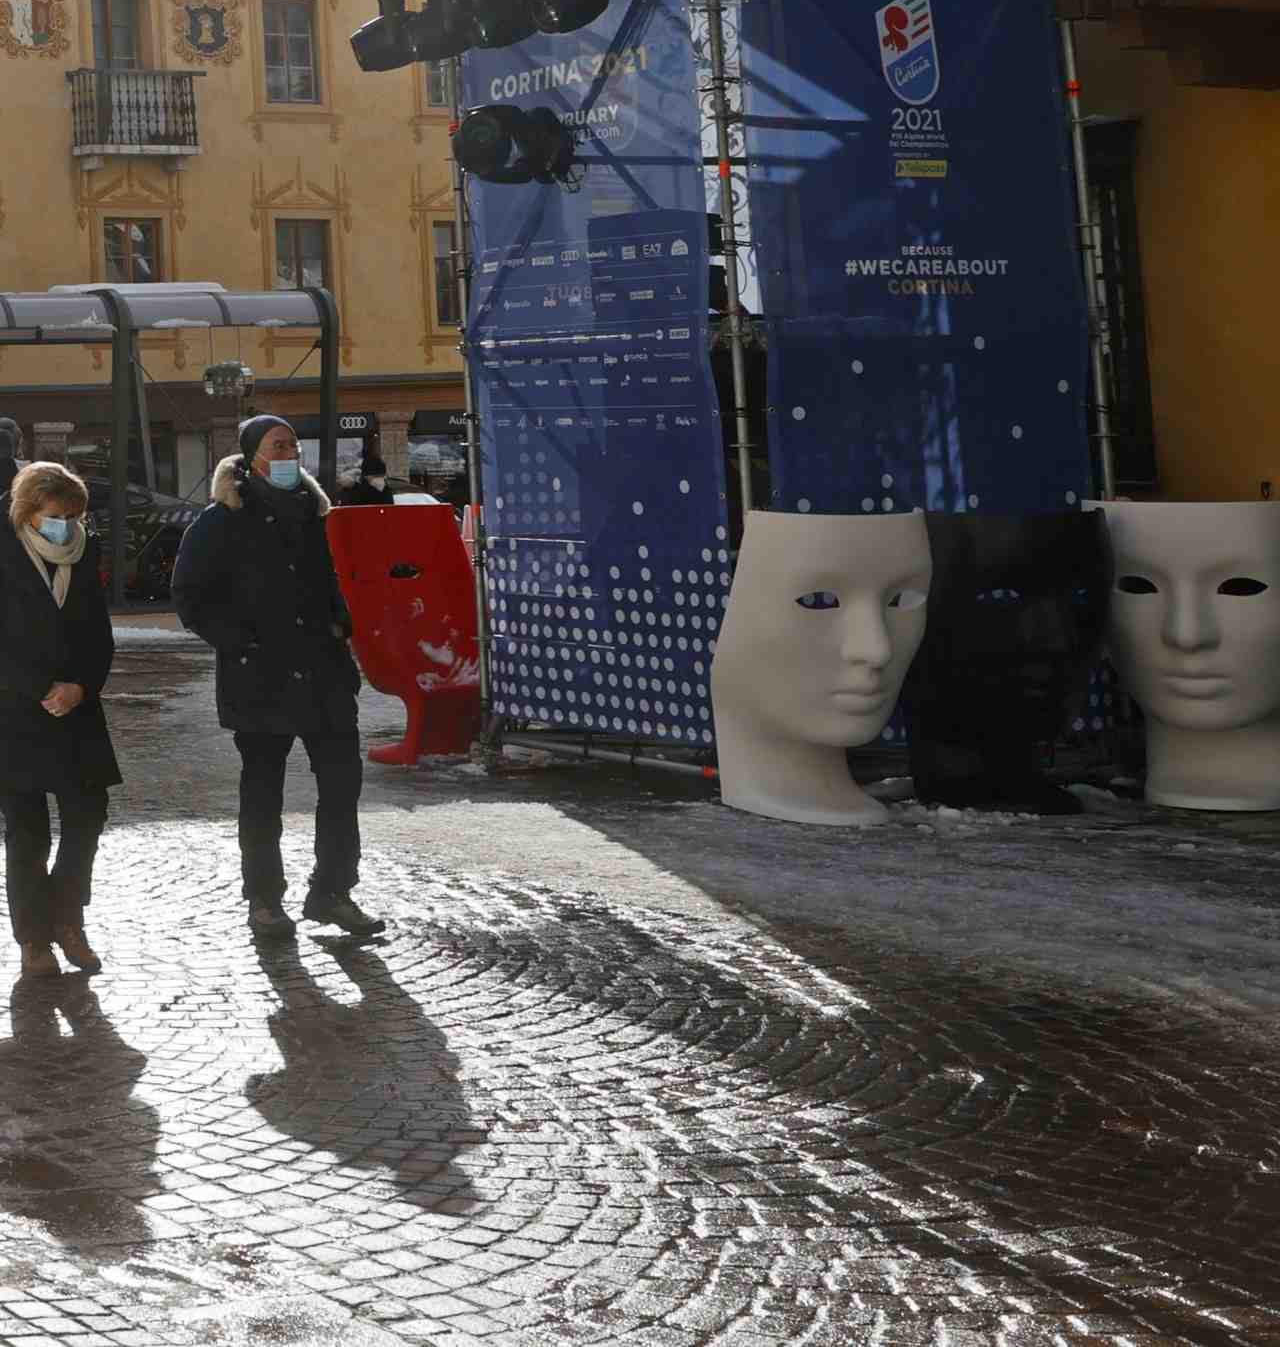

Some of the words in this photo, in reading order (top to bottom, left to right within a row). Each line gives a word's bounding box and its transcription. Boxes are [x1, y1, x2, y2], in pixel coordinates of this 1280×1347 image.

[491, 59, 583, 100] CORTINA
[891, 107, 942, 131] 2021
[901, 246, 953, 256] BECAUSE
[844, 259, 1009, 276] #WECAREABOUT
[887, 279, 975, 295] CORTINA
